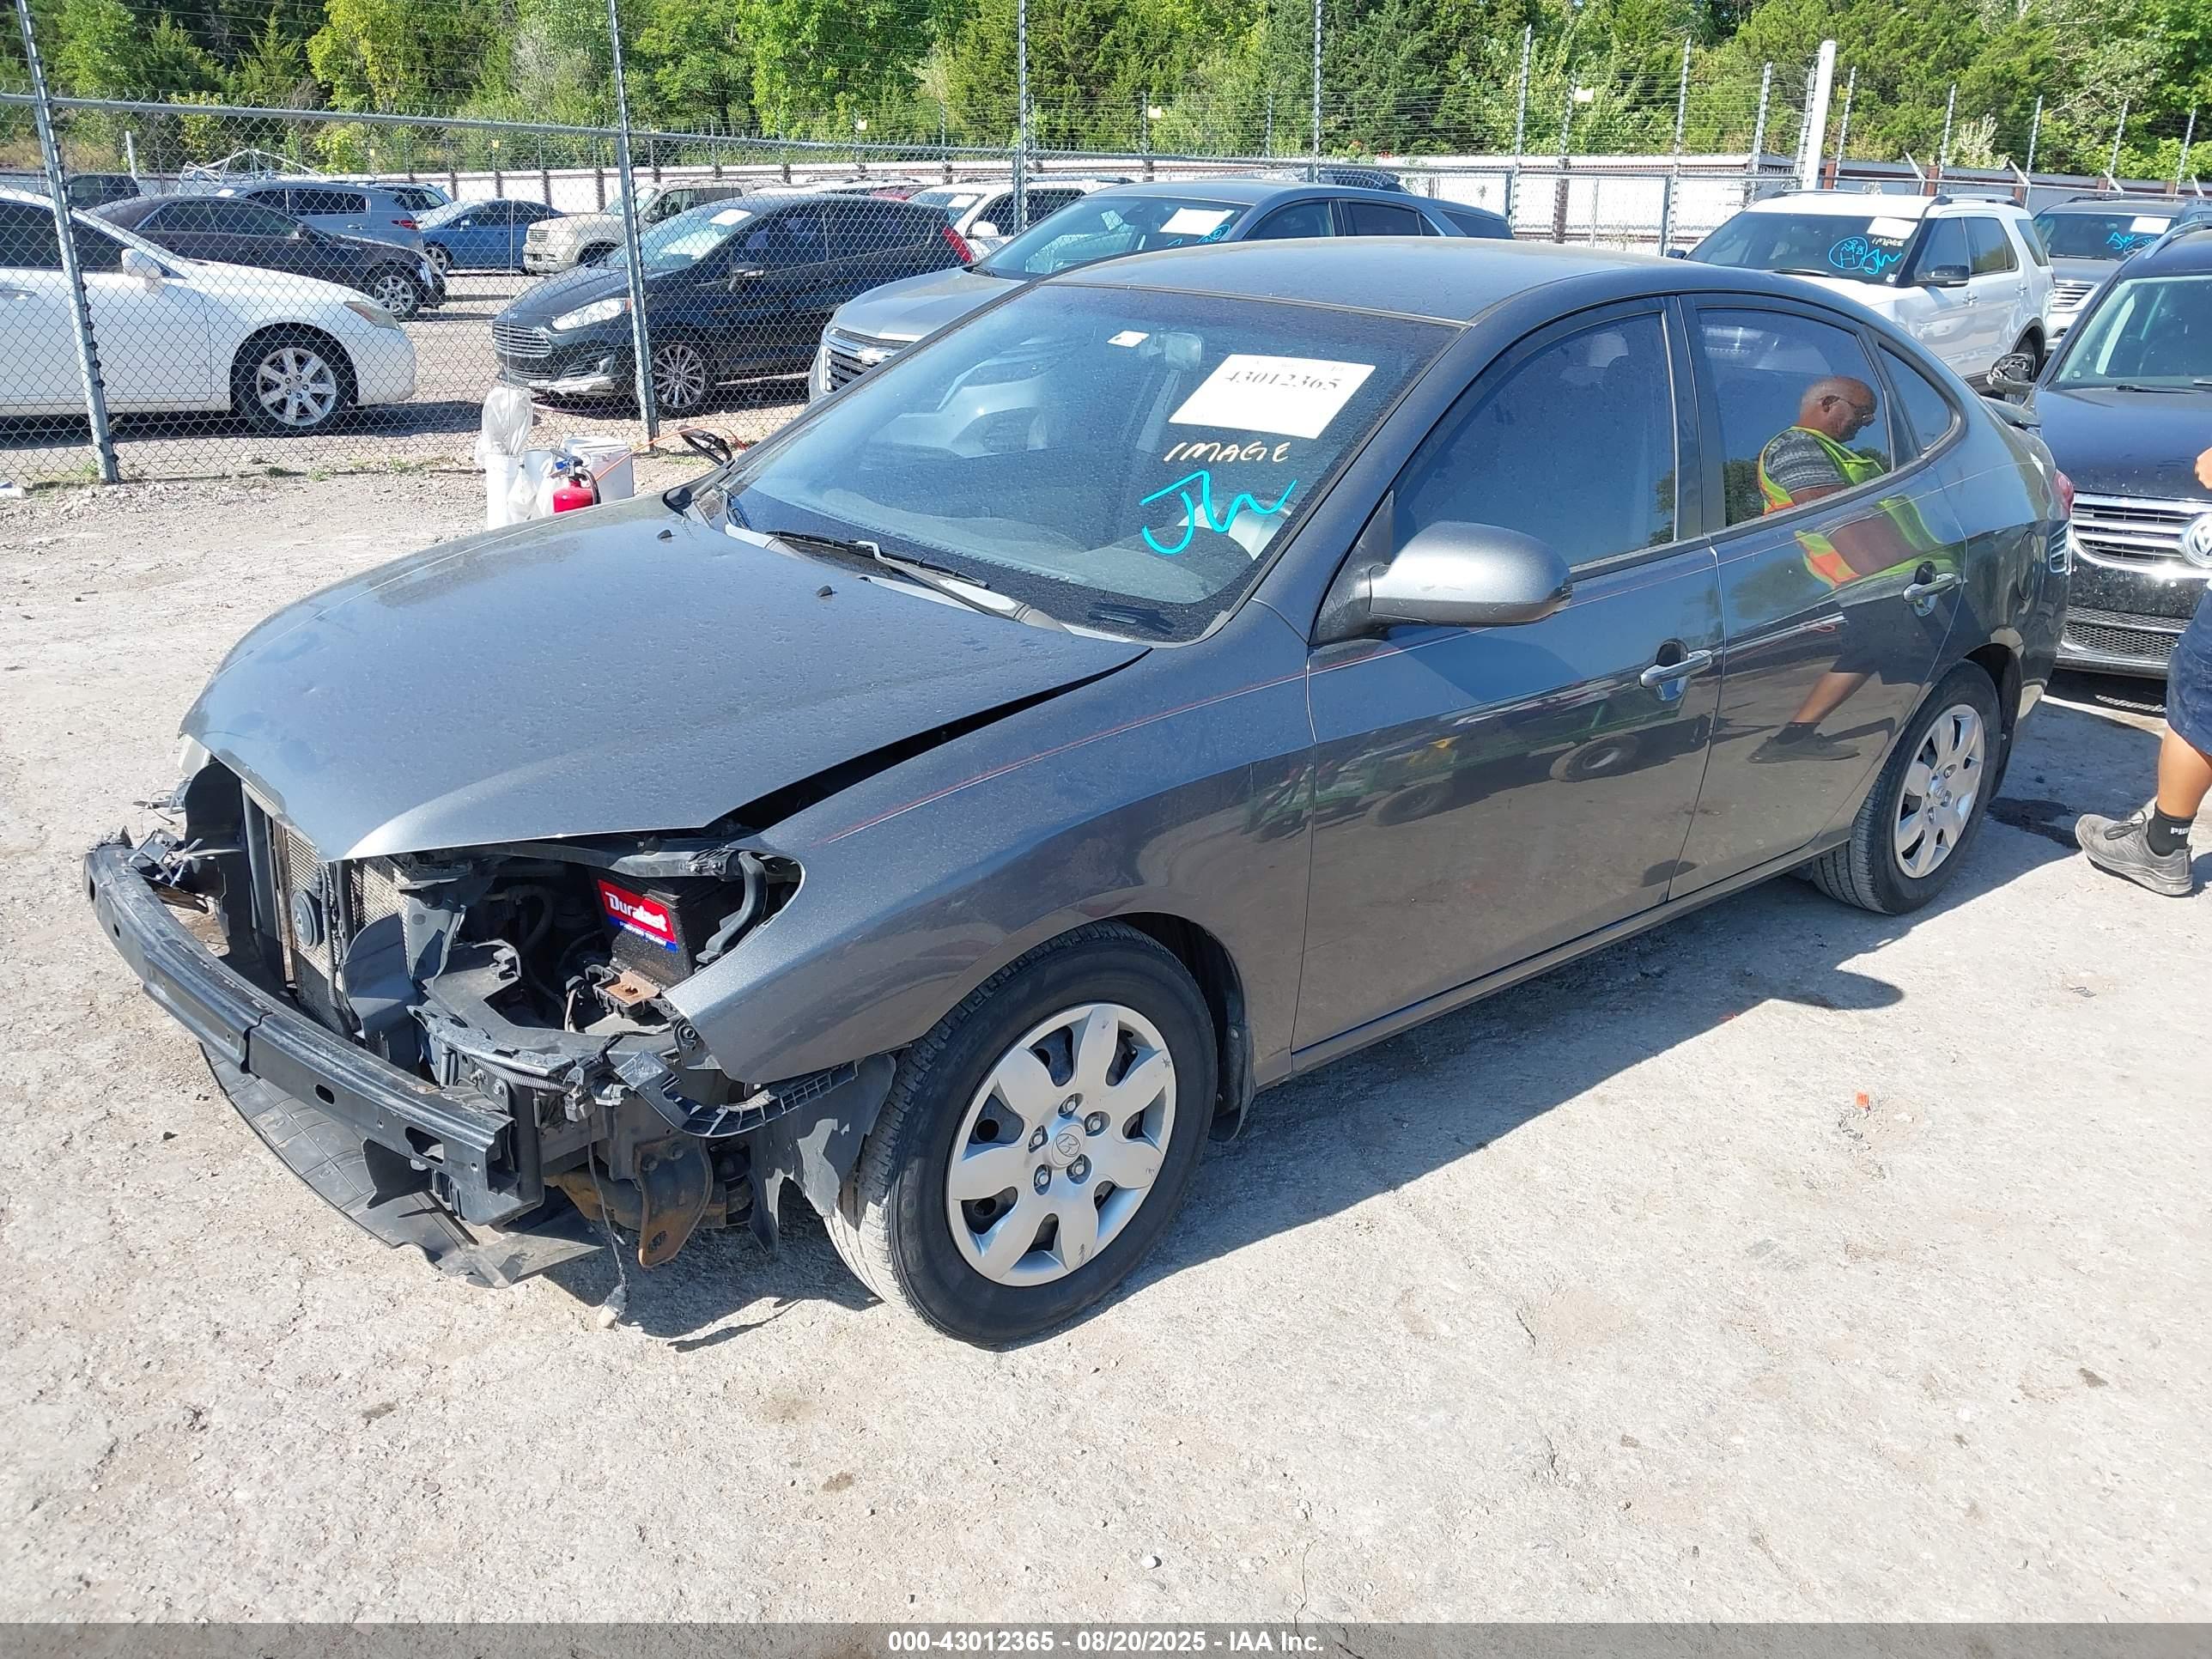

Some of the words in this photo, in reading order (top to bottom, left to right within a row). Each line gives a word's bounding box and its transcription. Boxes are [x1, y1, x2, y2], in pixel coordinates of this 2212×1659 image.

[1224, 370, 1341, 390] 43012365
[1164, 441, 1291, 463] IMAGE
[605, 891, 667, 932] Duralast
